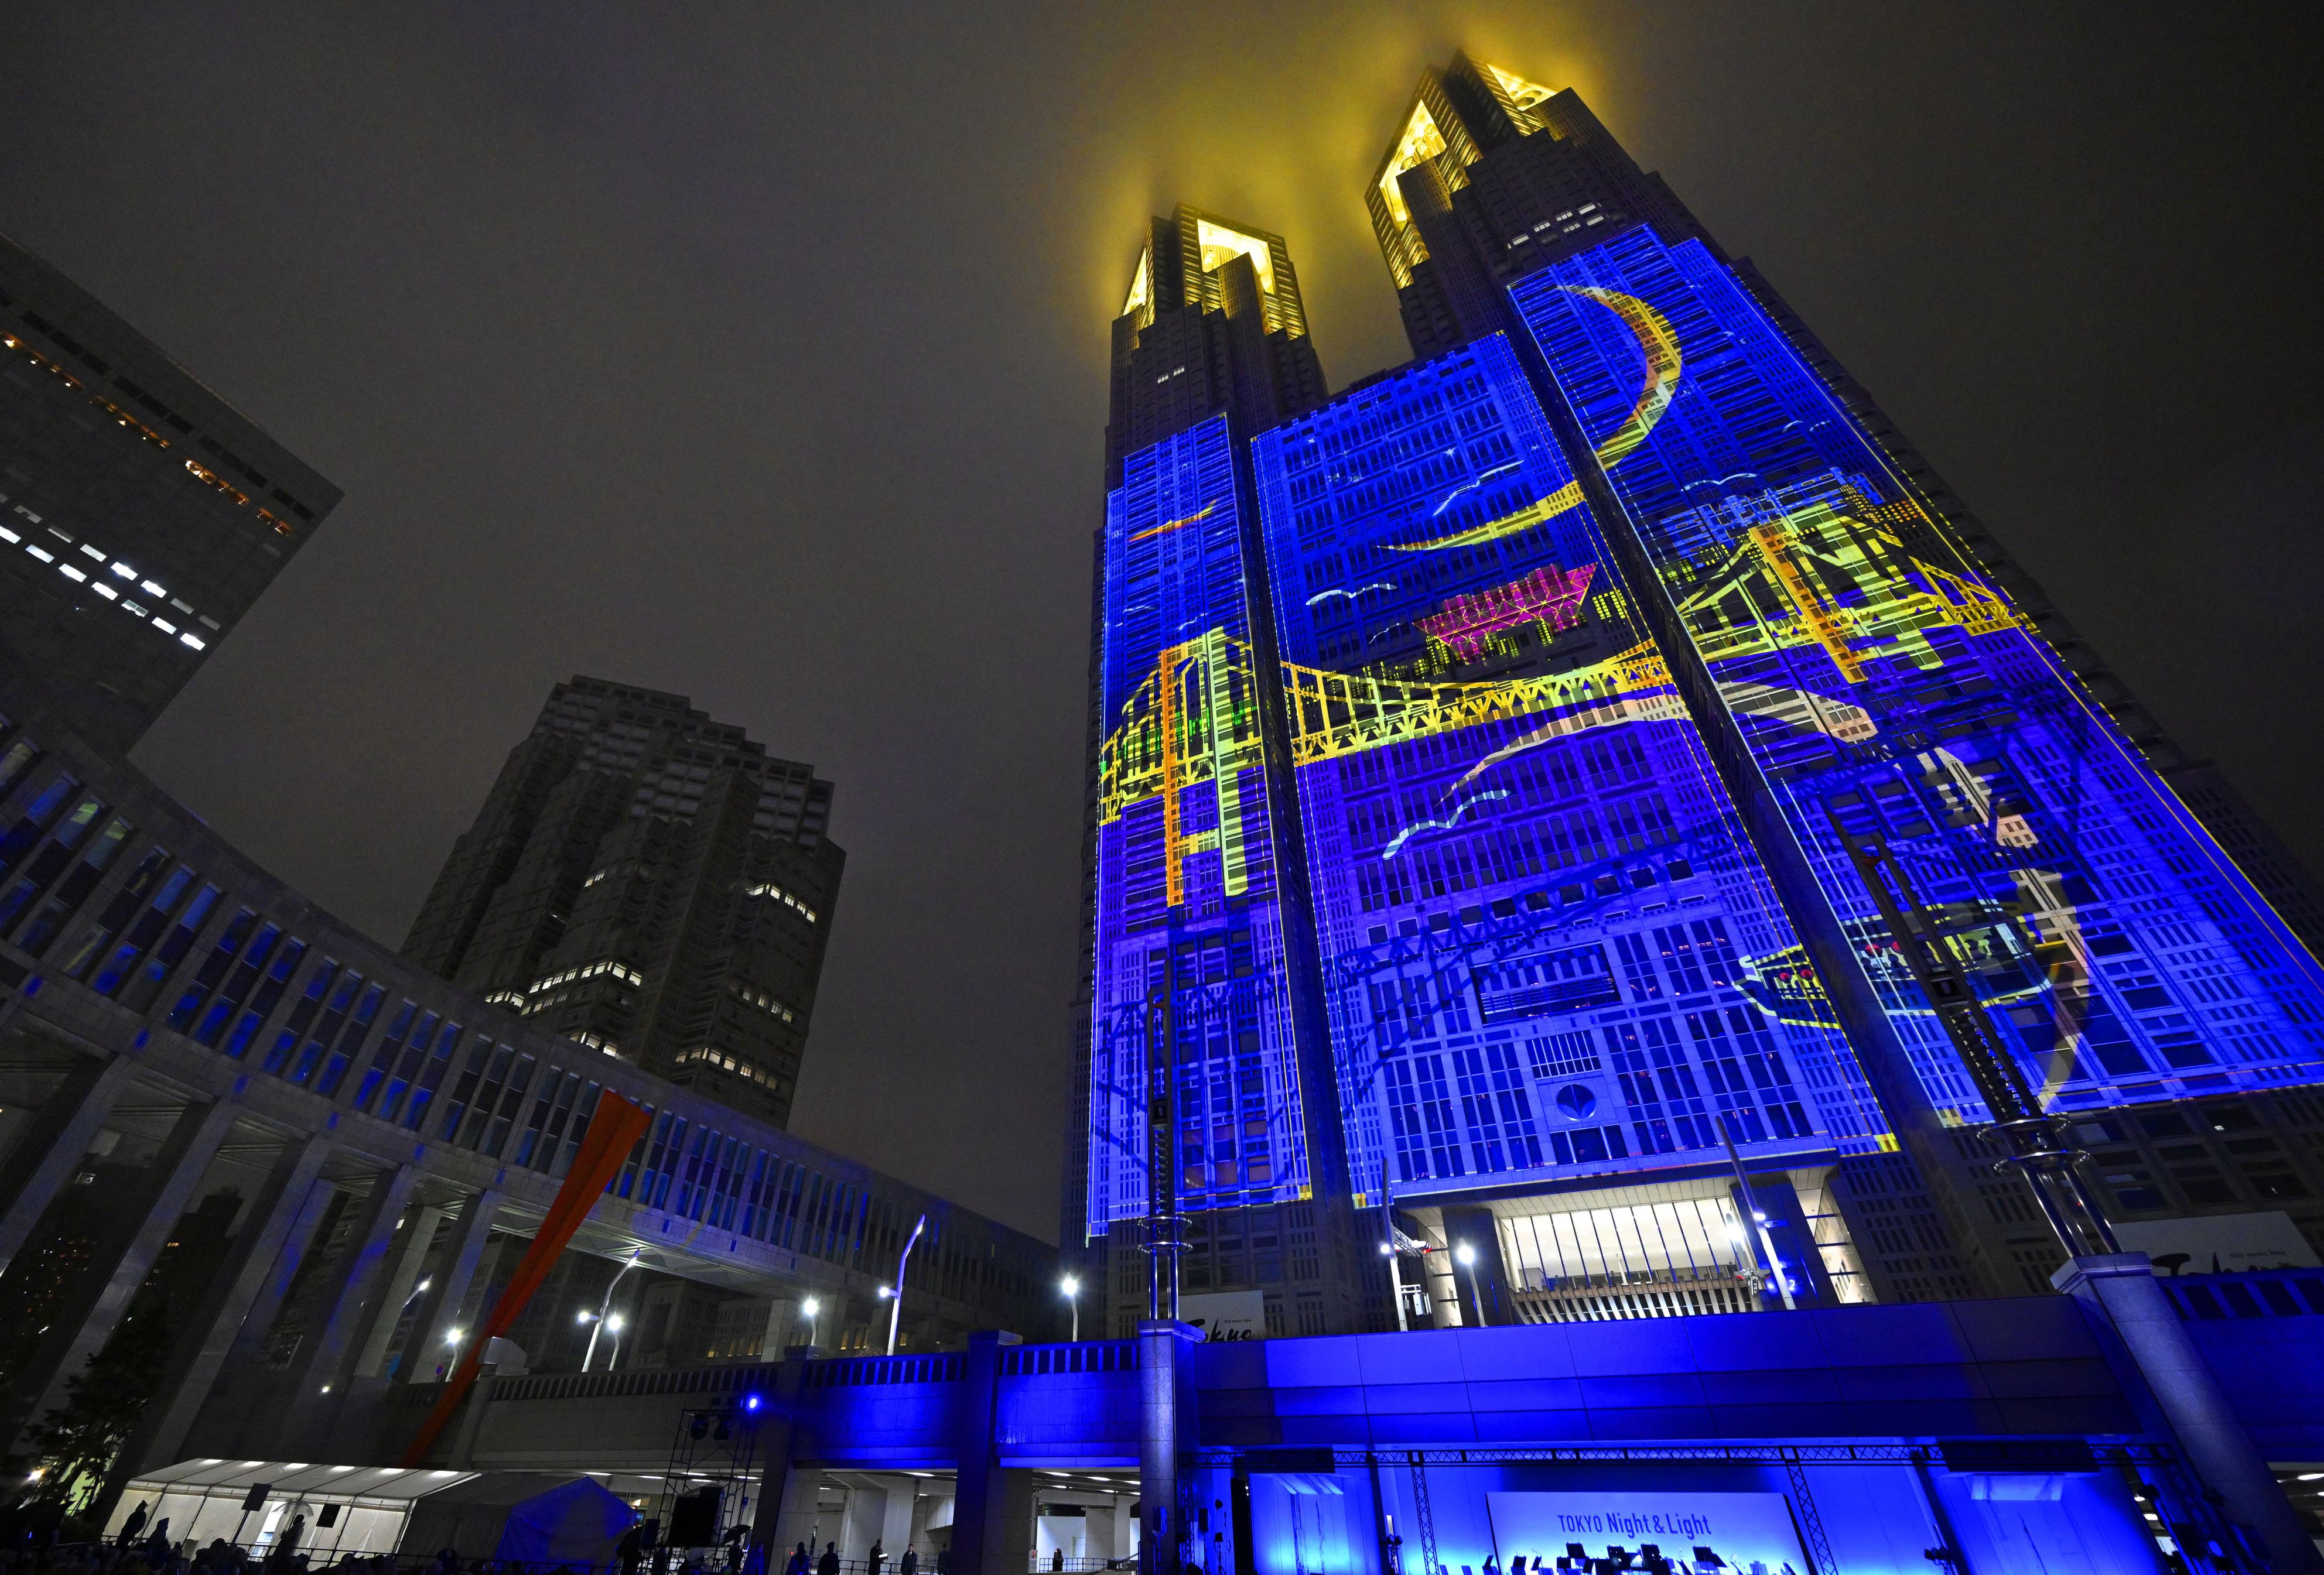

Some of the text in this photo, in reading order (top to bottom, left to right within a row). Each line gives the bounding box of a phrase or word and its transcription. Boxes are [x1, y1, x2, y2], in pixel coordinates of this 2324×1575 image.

[1557, 1512, 1712, 1540] TOKYO Night & Light
